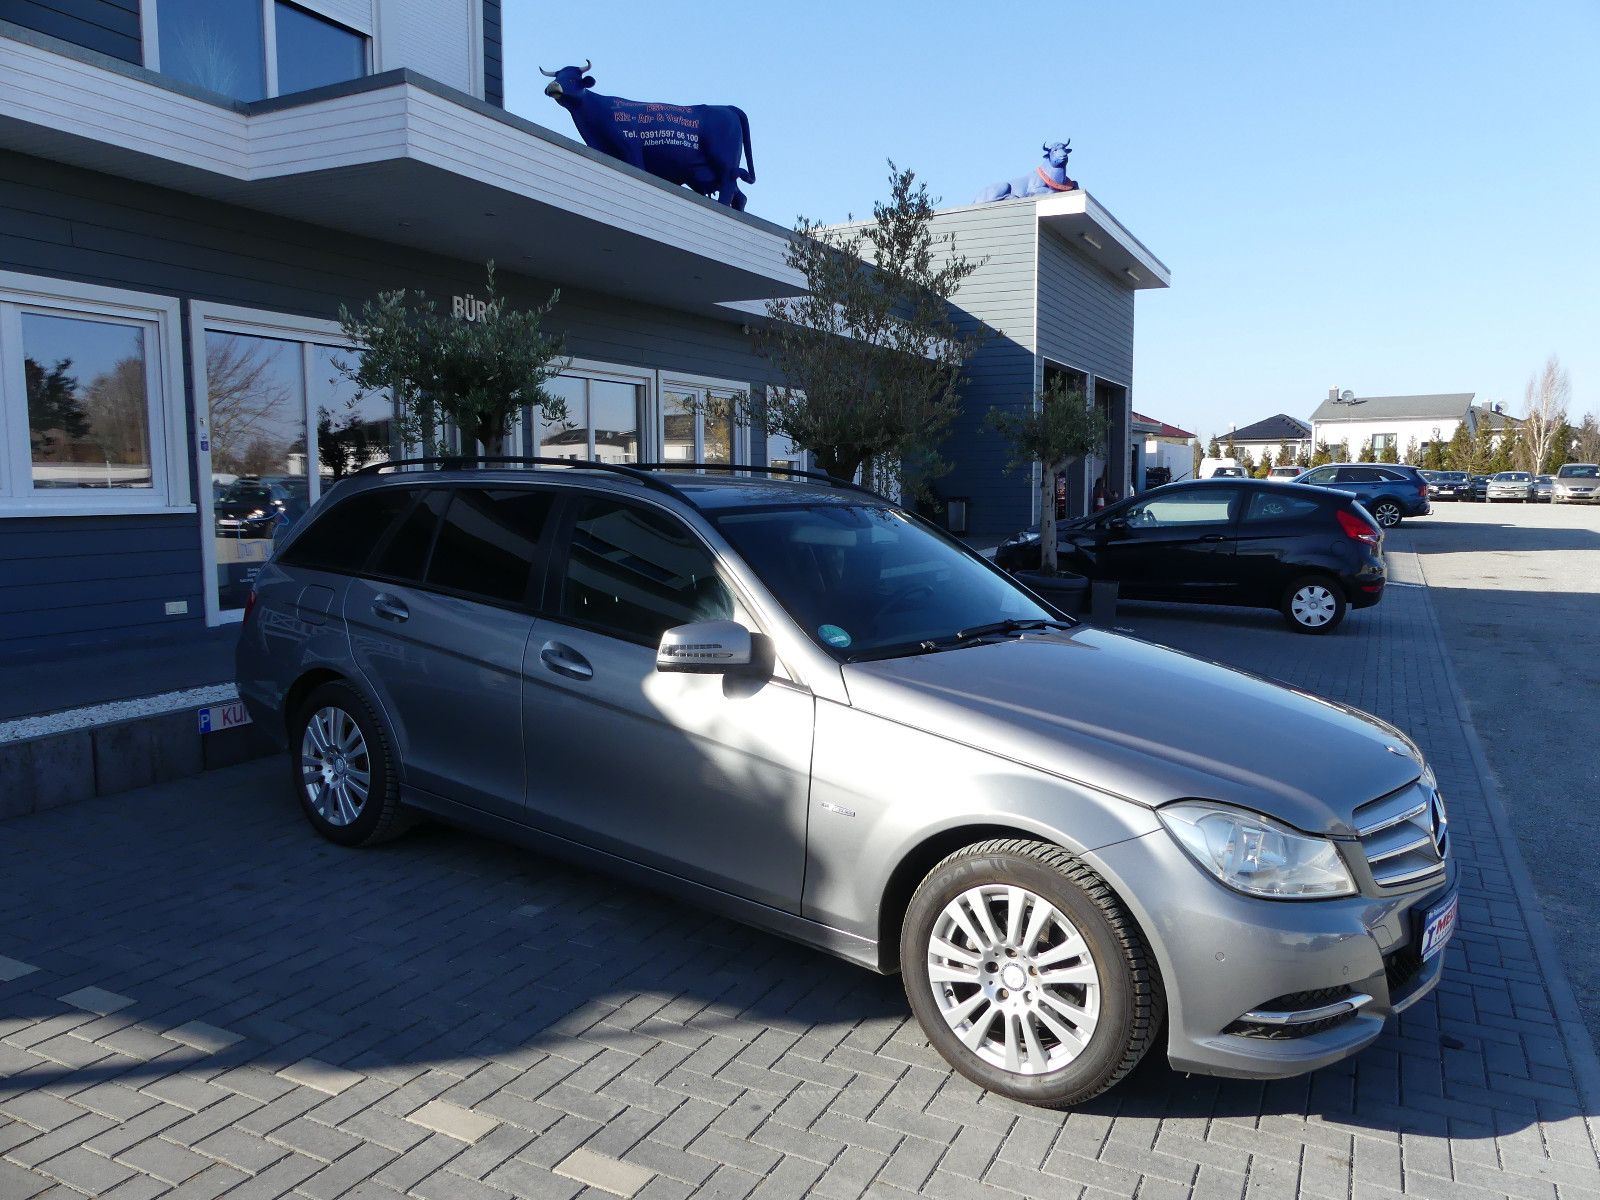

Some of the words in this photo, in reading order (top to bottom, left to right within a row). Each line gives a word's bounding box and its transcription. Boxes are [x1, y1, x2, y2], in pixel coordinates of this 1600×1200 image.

[622, 130, 638, 139] Tel.
[640, 129, 675, 140] 0391/597
[686, 133, 699, 143] 100
